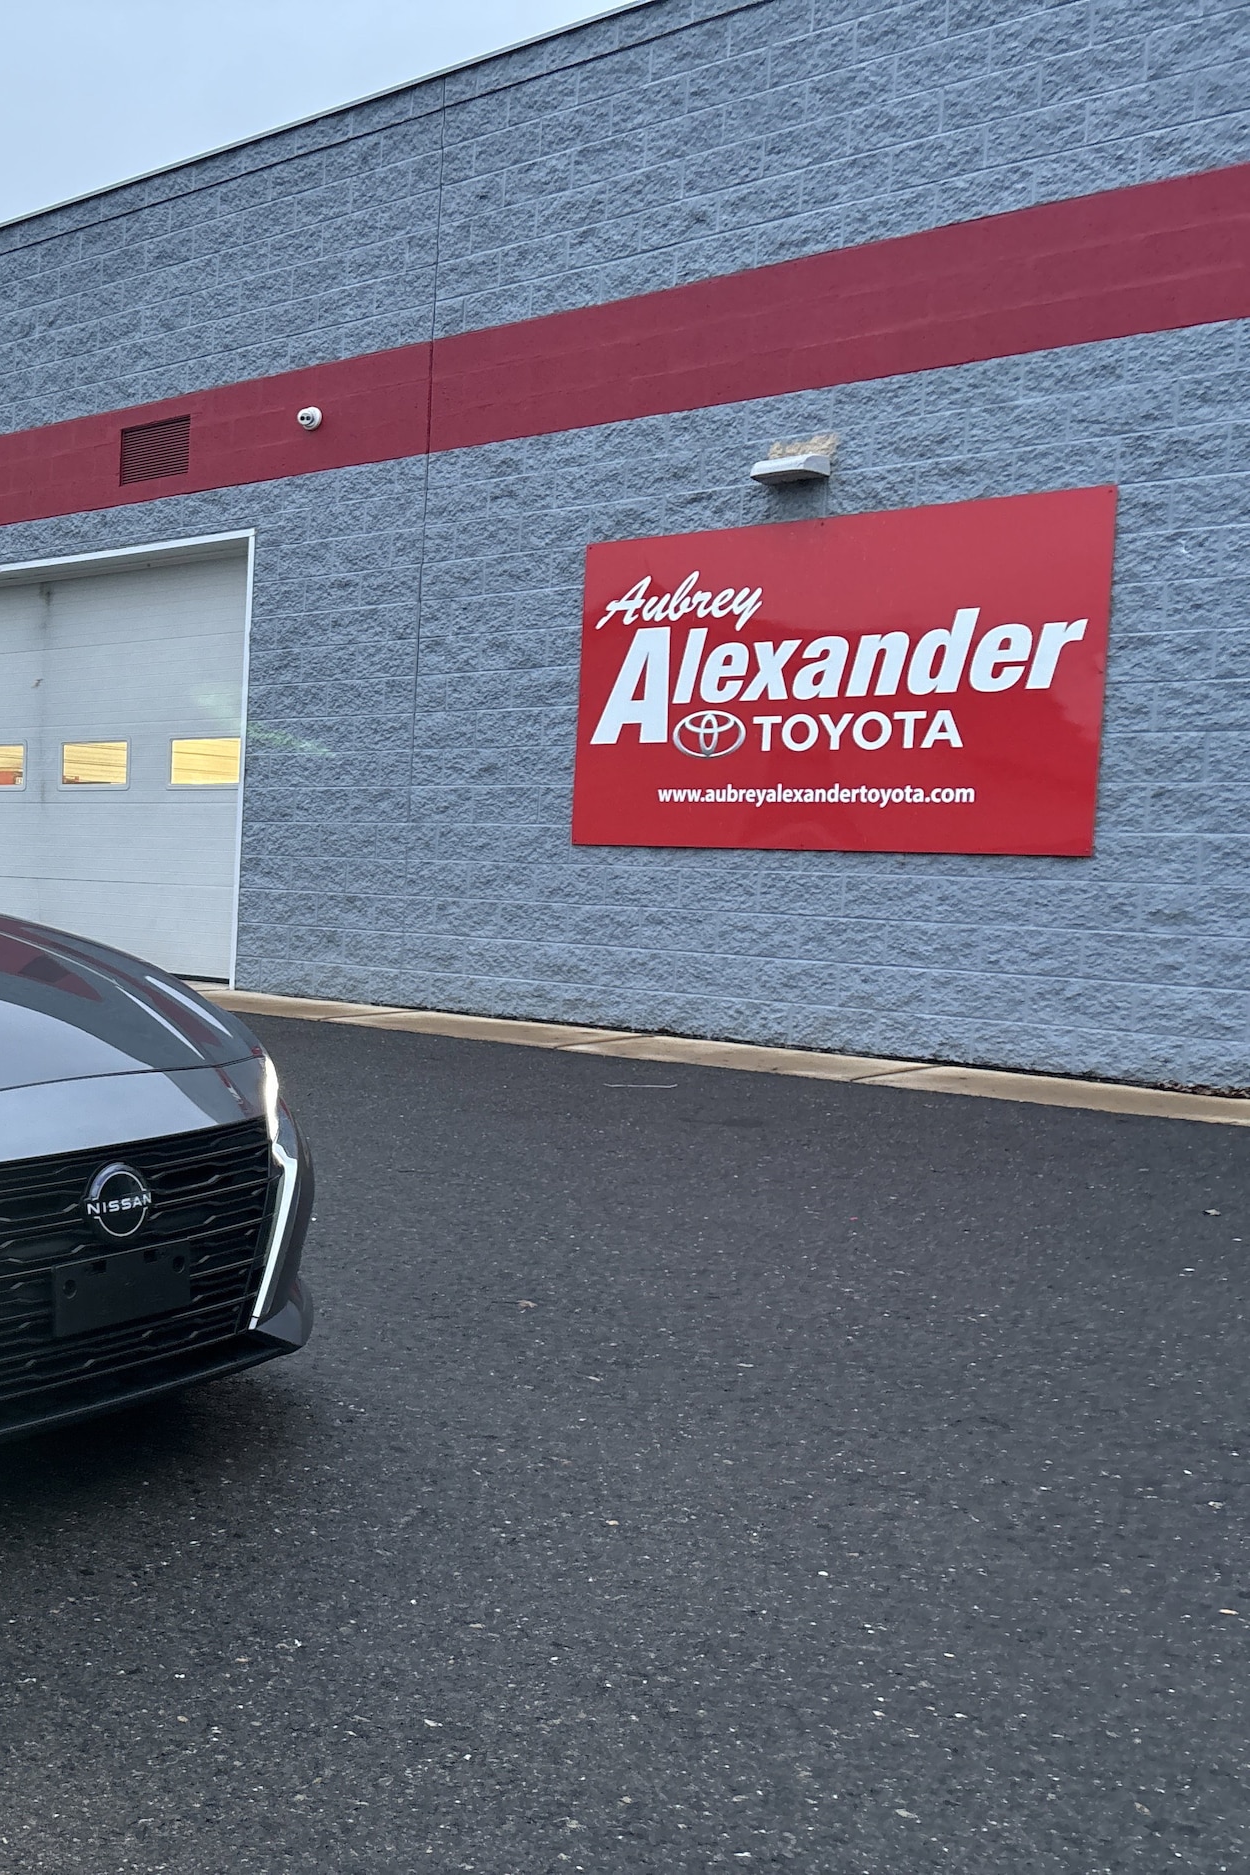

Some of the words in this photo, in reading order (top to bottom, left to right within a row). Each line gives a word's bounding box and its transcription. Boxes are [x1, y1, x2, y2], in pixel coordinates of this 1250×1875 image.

[595, 570, 763, 631] Aubrey
[589, 607, 1089, 745] Alexander
[752, 709, 964, 752] TOYOTA
[657, 783, 975, 808] www.aubreyalexandertoyota.com
[86, 1192, 152, 1215] NISSAN
